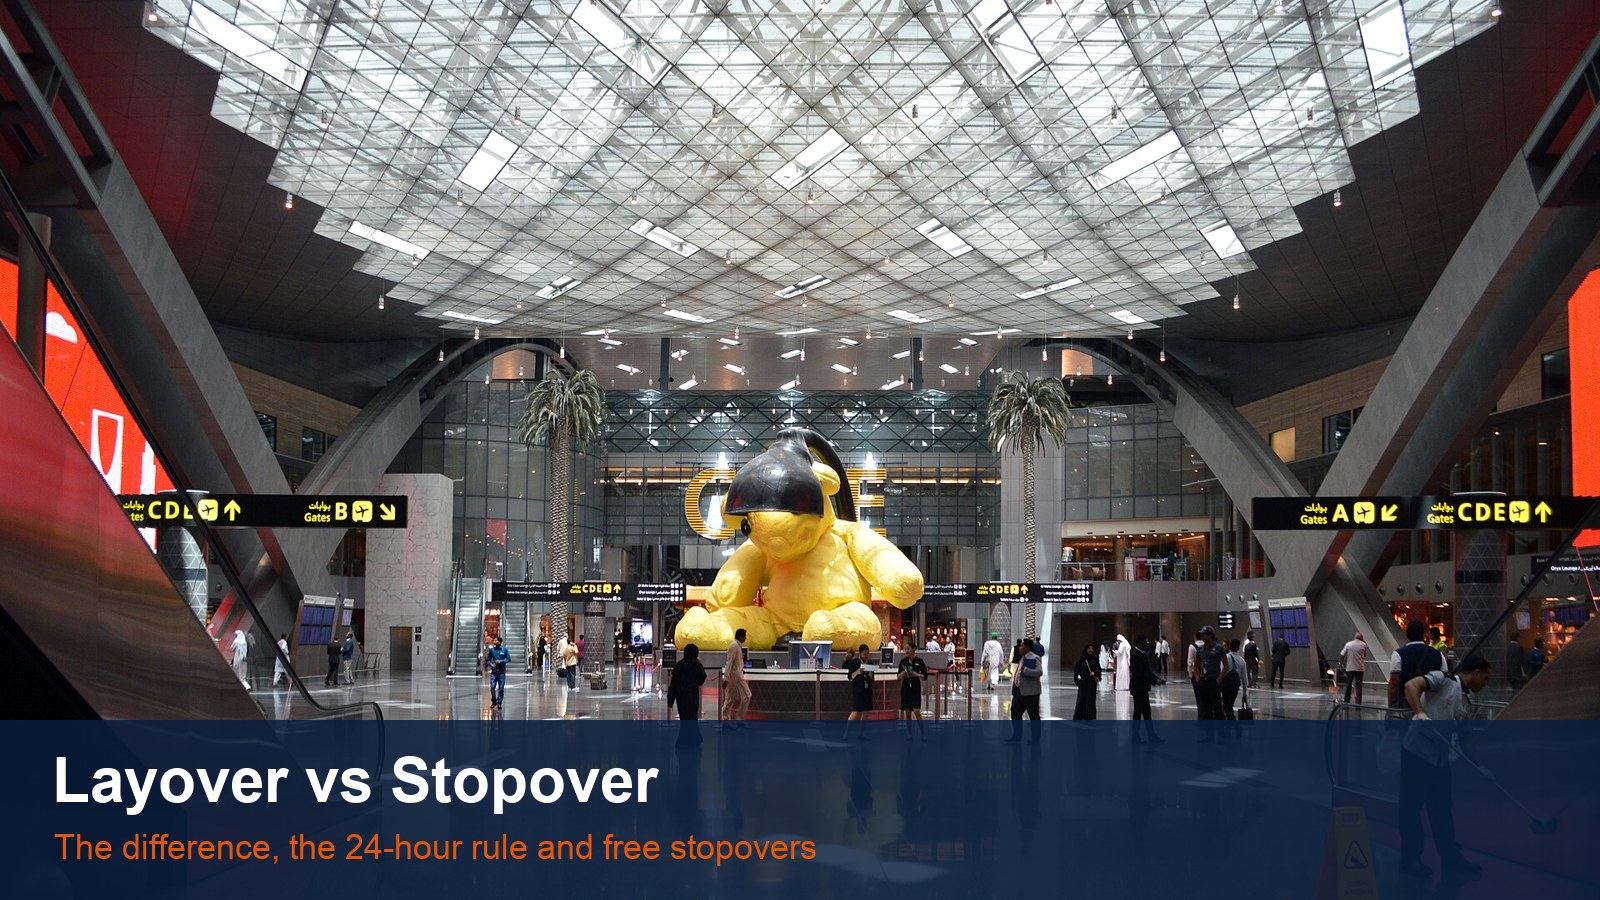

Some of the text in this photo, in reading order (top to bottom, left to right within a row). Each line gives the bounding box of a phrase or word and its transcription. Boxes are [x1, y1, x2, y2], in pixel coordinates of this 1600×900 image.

[308, 501, 332, 512] بوابات
[334, 501, 348, 521] B
[1304, 502, 1328, 513] بوابات
[1431, 501, 1455, 512] بوابات
[303, 512, 331, 523] Gates
[1331, 503, 1350, 523] A
[1426, 513, 1455, 524] Gates
[1300, 514, 1328, 525] Gates
